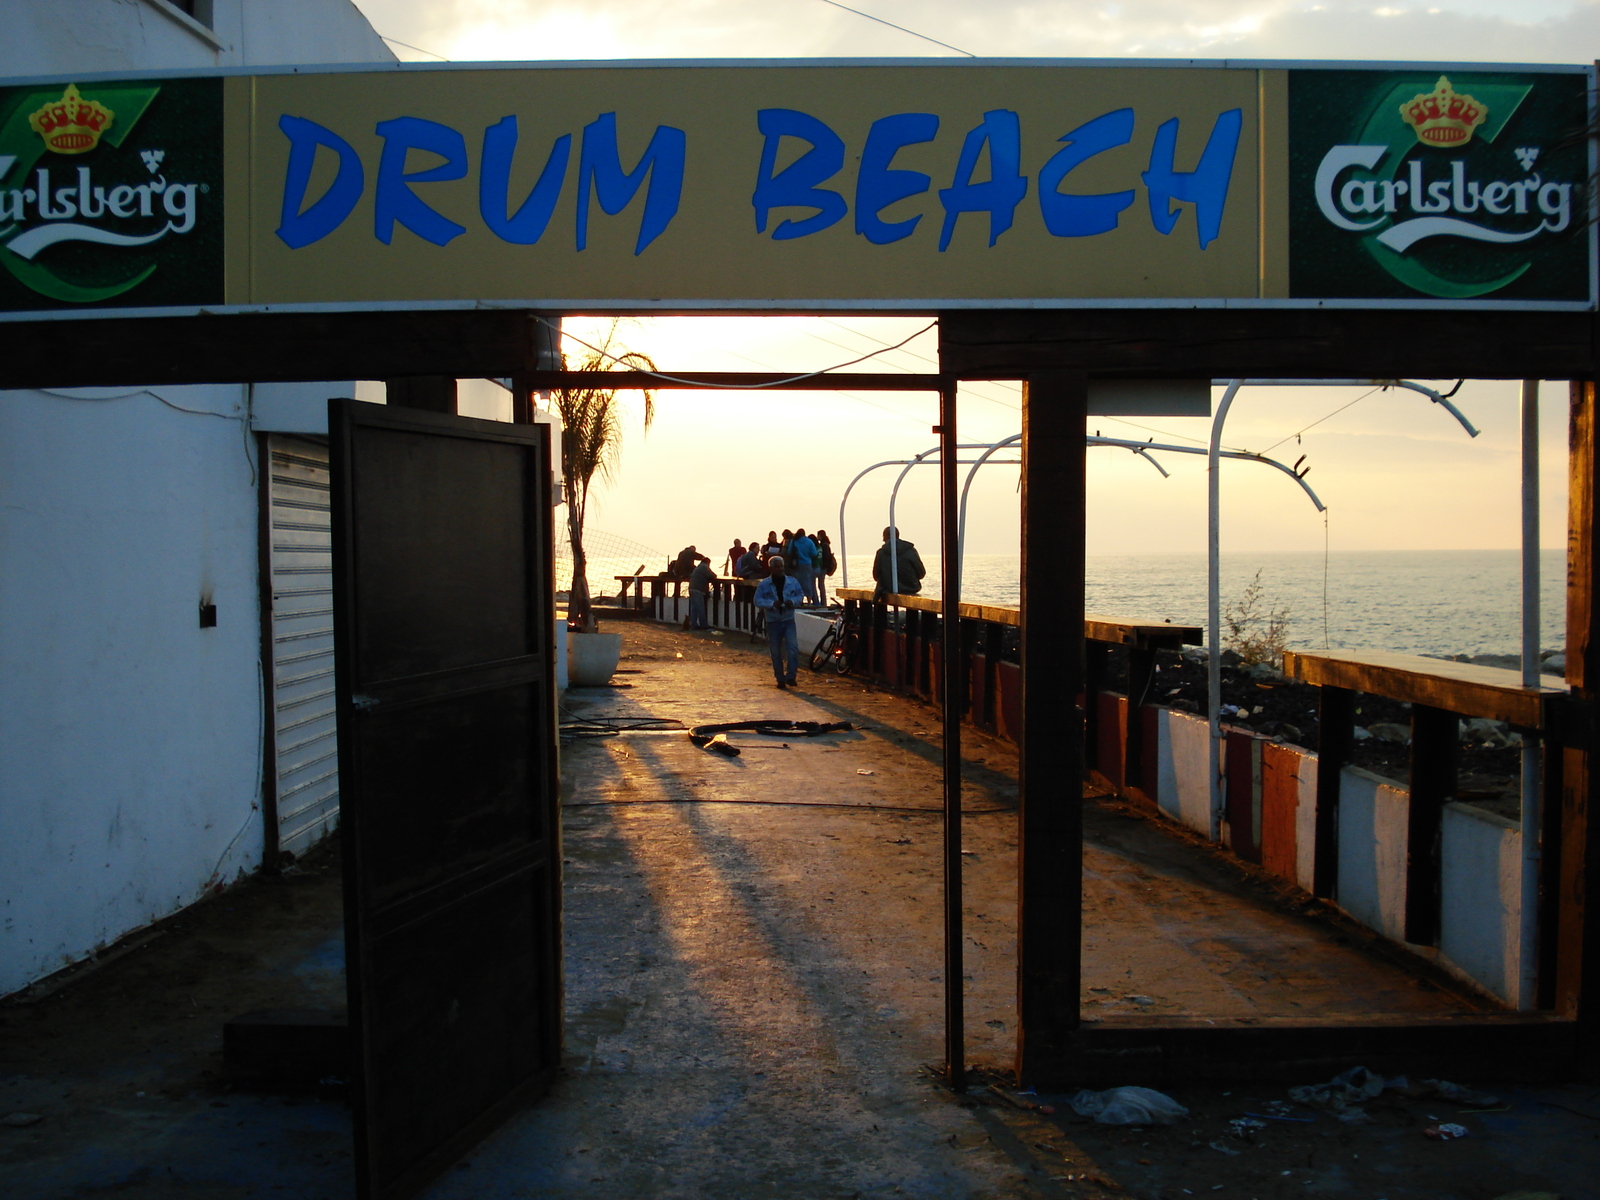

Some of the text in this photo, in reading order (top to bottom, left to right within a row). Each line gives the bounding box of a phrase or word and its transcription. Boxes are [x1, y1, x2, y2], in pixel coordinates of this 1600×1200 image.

[0, 151, 198, 234] rlsberg
[275, 107, 1243, 257] DRUM BEACH
[1314, 145, 1572, 234] Carlsberg
